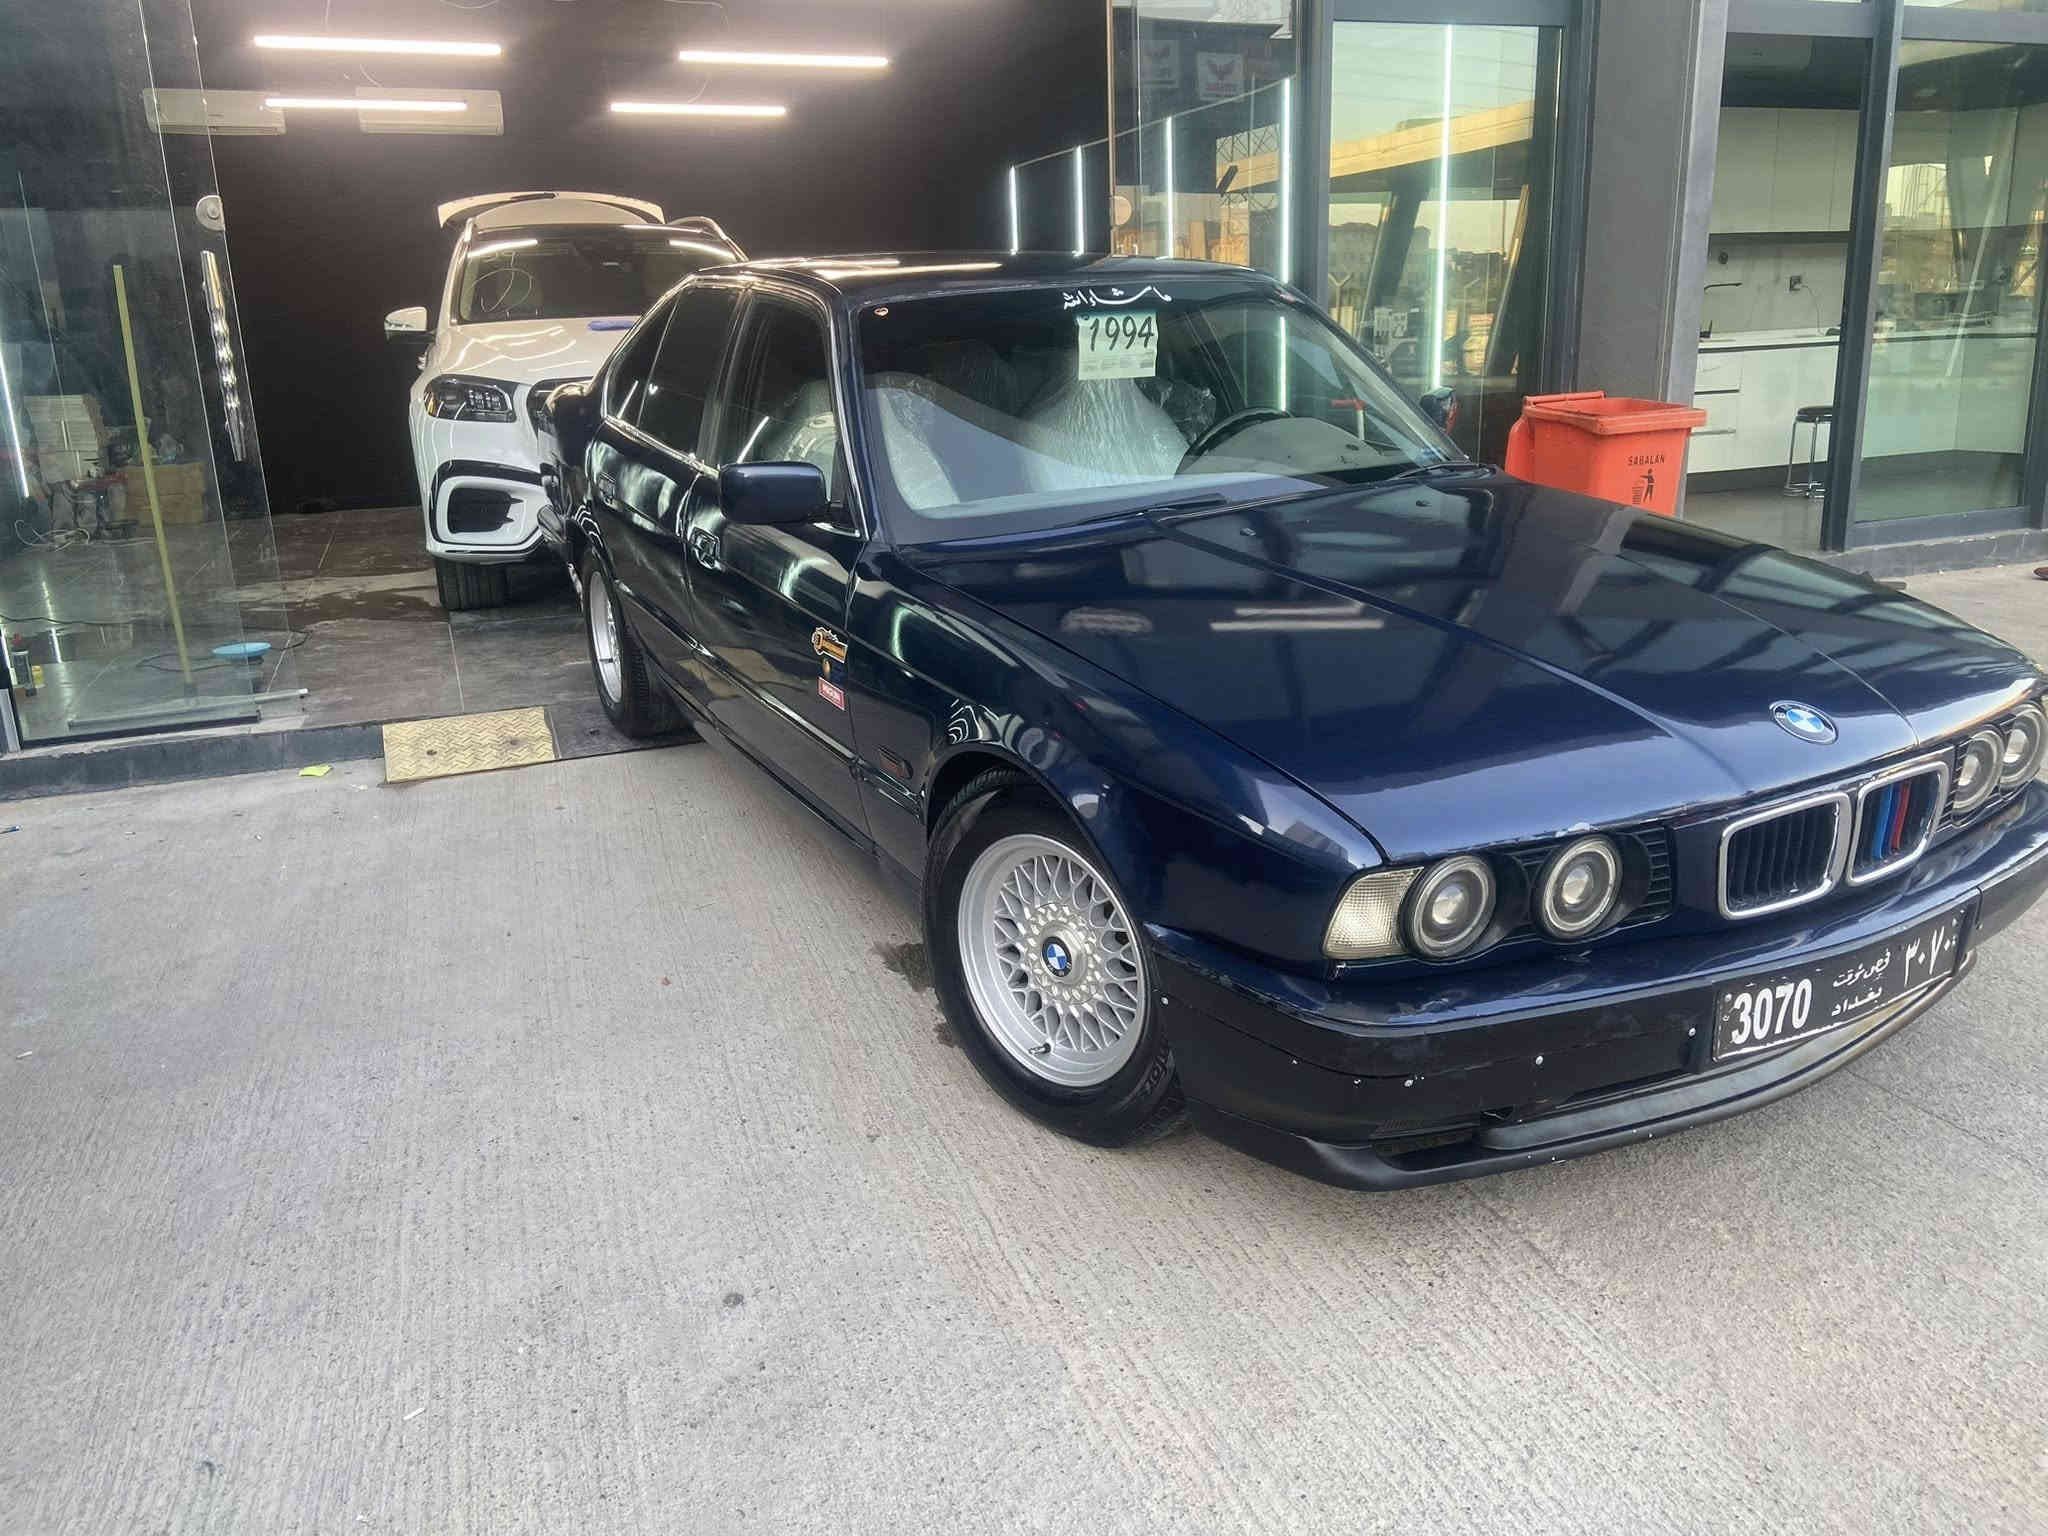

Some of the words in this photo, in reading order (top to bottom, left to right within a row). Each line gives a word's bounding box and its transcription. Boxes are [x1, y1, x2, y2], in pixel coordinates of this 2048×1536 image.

[1089, 315, 1155, 352] 1994
[1627, 454, 1665, 466] SABALAN
[1731, 978, 1813, 1045] 3070
[1831, 986, 1883, 1017] بغداد
